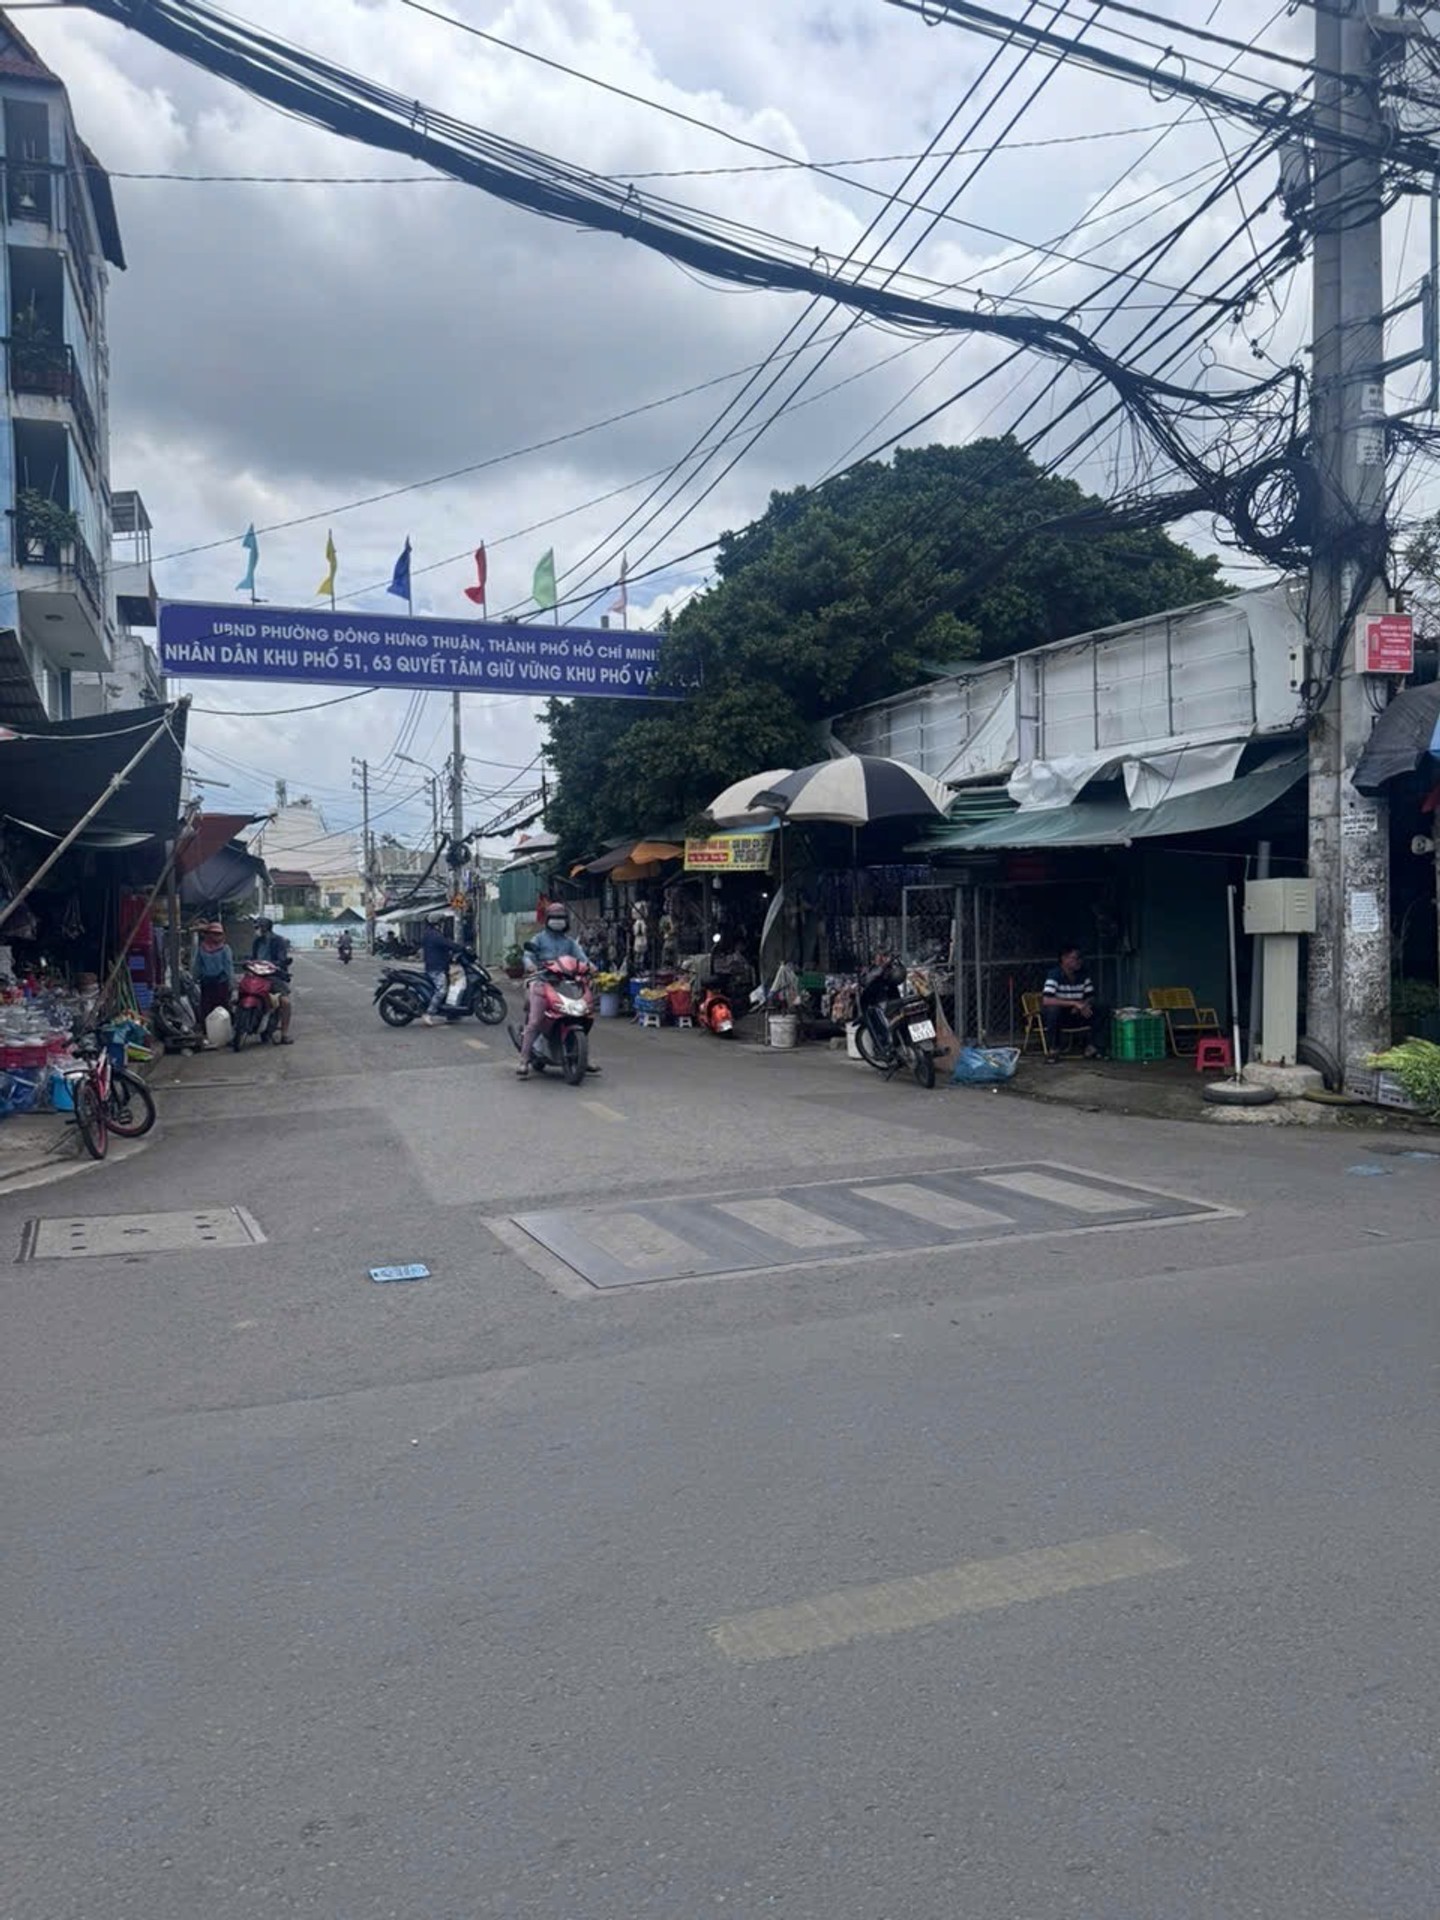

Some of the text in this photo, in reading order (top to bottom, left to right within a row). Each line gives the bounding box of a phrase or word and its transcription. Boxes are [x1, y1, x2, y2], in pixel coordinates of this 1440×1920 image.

[213, 622, 256, 638] UBND
[261, 624, 329, 642] PHƯỜNG
[333, 627, 380, 645] ĐÔNG
[384, 631, 428, 648] HƯNG
[432, 634, 485, 654] THUẬN,
[488, 637, 536, 654] THÀNH
[540, 639, 569, 656] PHỐ
[597, 644, 622, 660] CHÍ
[165, 640, 216, 662] NHÂN
[221, 642, 258, 664] DÂN
[263, 648, 299, 667] KHU
[303, 646, 340, 668] PHỐ
[344, 653, 369, 673] 51,
[372, 655, 392, 672] 63
[396, 652, 446, 674] QUYẾT
[449, 656, 483, 676] TÂM
[487, 658, 515, 679] GIỮ
[519, 660, 562, 681] VỮNG
[566, 666, 596, 682] KHU
[600, 662, 631, 685] PHỐ
